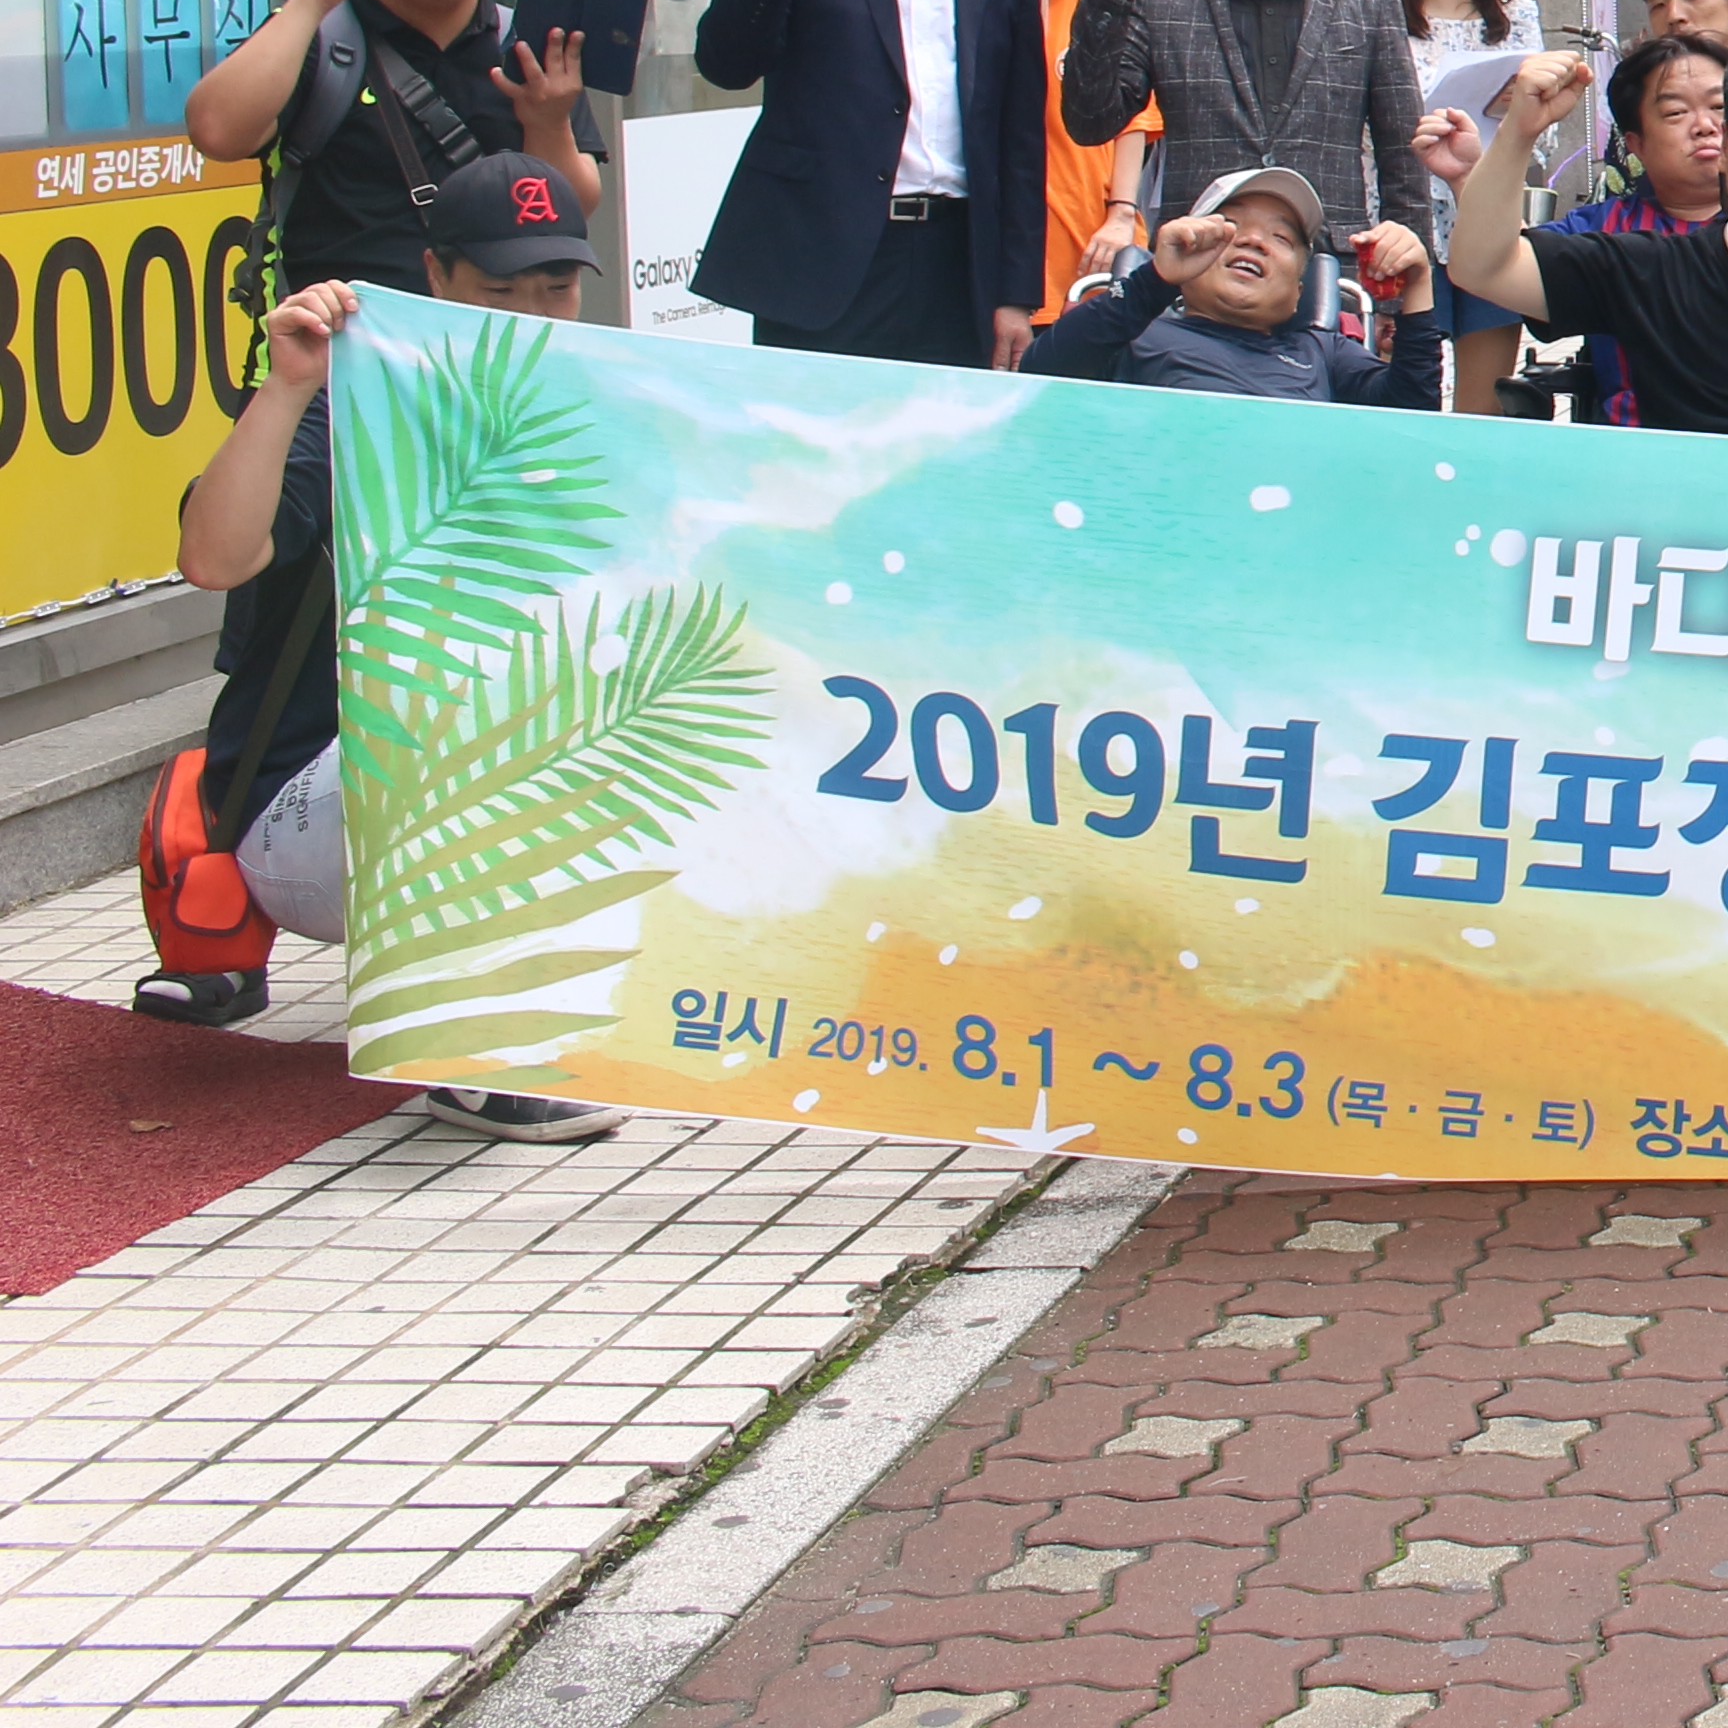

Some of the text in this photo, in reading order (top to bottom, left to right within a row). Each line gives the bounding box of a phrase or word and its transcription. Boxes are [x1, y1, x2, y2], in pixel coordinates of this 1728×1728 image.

[36, 142, 205, 199] 연세 공인중개사
[511, 176, 558, 225] A
[634, 255, 692, 291] Galaxy
[652, 311, 666, 325] The
[812, 673, 1315, 884] 2019년
[670, 988, 790, 1059] 일시
[807, 1016, 929, 1072] 2019.
[950, 1014, 1059, 1090] 8.1
[1090, 1050, 1161, 1084] ~
[1186, 1043, 1307, 1121] 8.3
